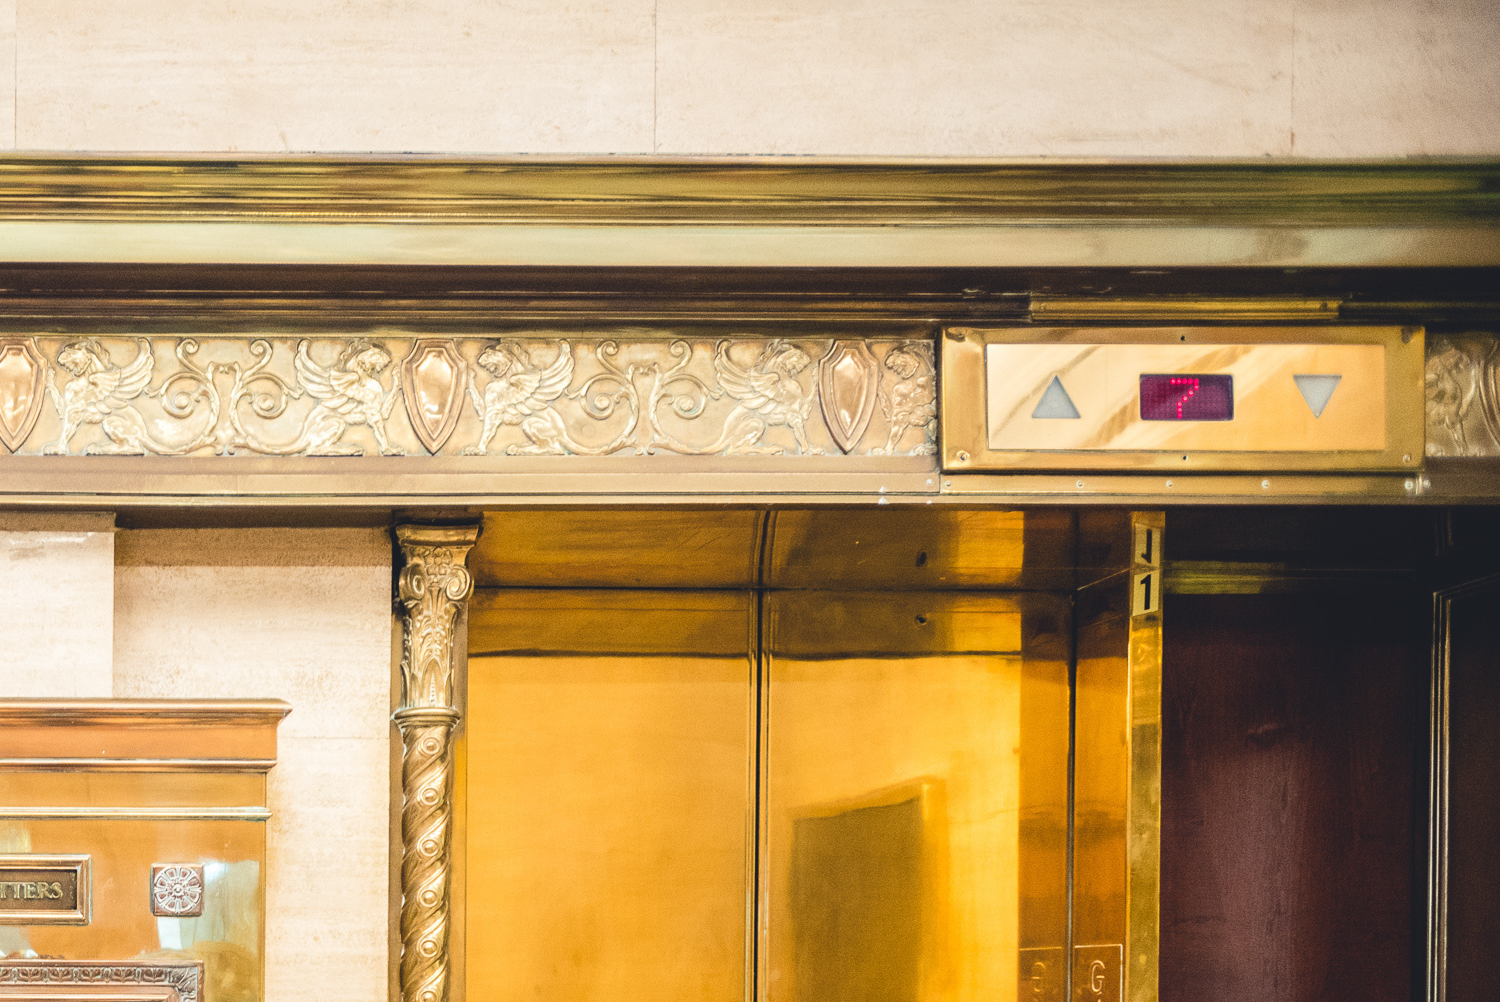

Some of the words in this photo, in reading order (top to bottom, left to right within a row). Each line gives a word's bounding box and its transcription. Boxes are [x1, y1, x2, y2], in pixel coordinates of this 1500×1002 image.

[1169, 378, 1200, 419] 7
[1139, 574, 1152, 611] 1
[1089, 959, 1106, 993] G
